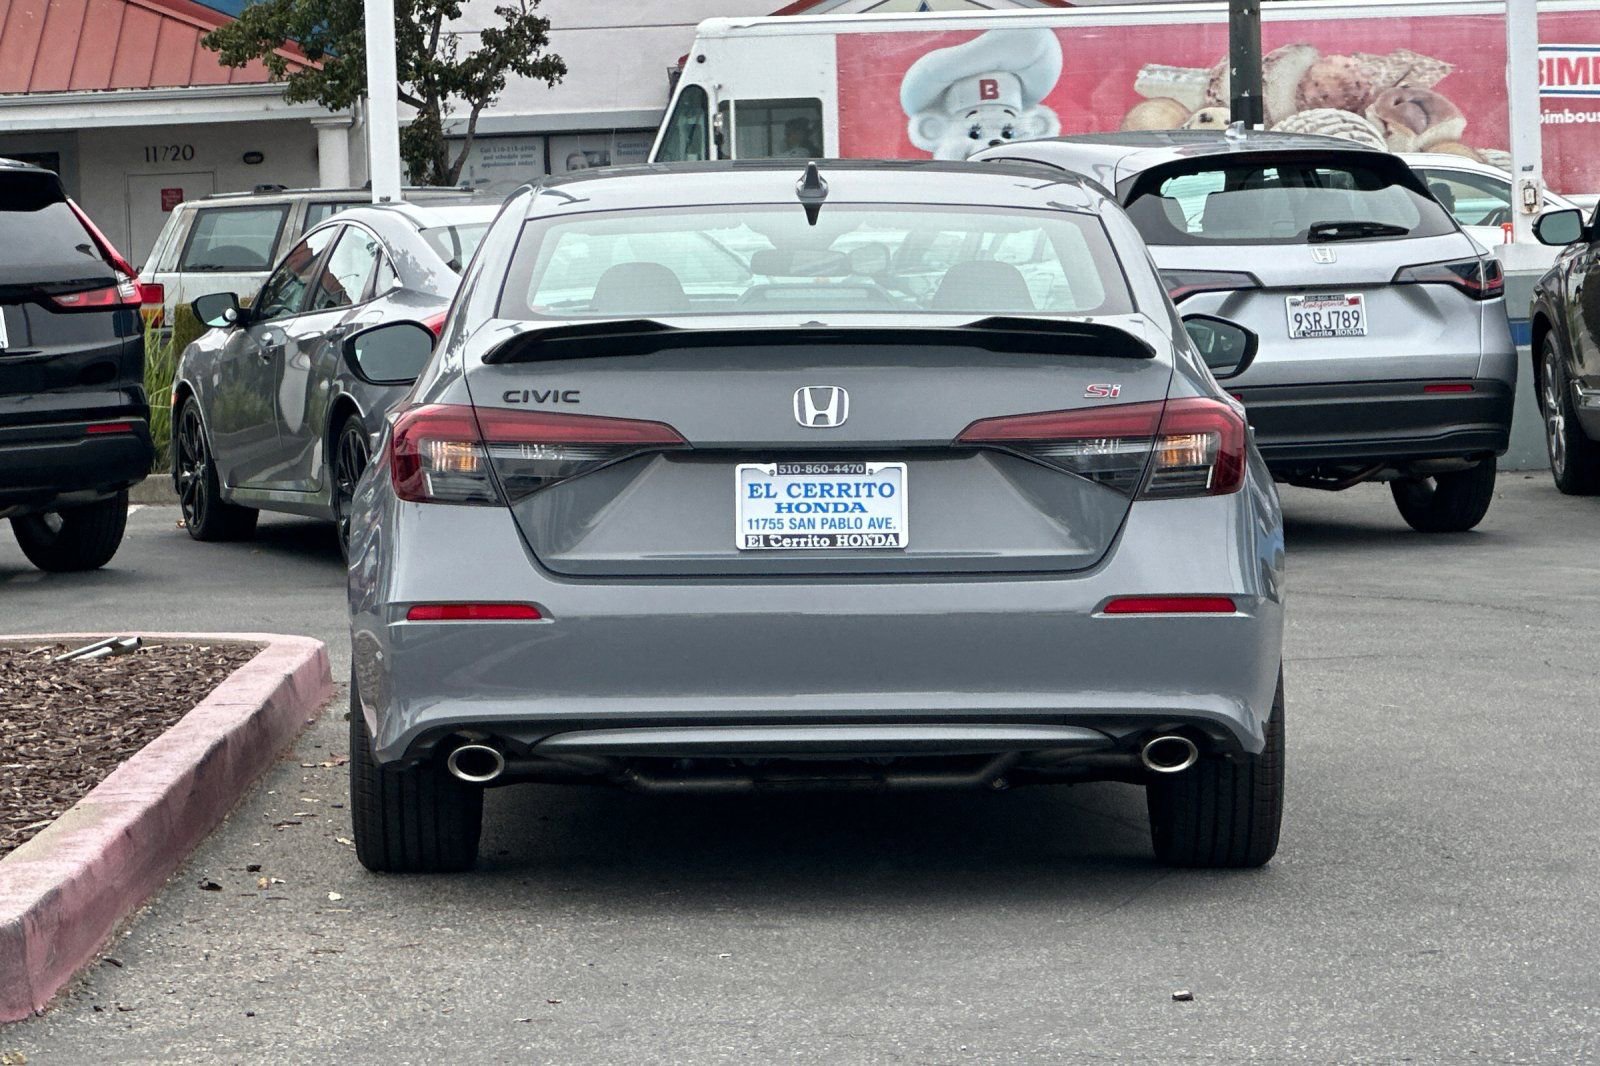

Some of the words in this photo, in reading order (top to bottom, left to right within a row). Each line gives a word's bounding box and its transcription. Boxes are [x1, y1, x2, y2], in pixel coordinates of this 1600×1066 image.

[979, 79, 999, 100] B
[145, 144, 194, 162] 11720
[1294, 310, 1360, 331] 9SRJ789
[502, 389, 580, 403] CIVIC
[1083, 383, 1121, 398] Si
[778, 464, 864, 474] 510-860-4470
[748, 483, 777, 499] EL
[786, 482, 895, 499] CERRITO
[775, 502, 868, 514] HONDA
[748, 518, 784, 530] 11755
[789, 518, 816, 530] SAN
[821, 517, 863, 529] PABLO
[868, 517, 897, 530] AVE.
[747, 536, 764, 547] El
[769, 535, 830, 547] Cerrito
[835, 534, 899, 547] HONDA
